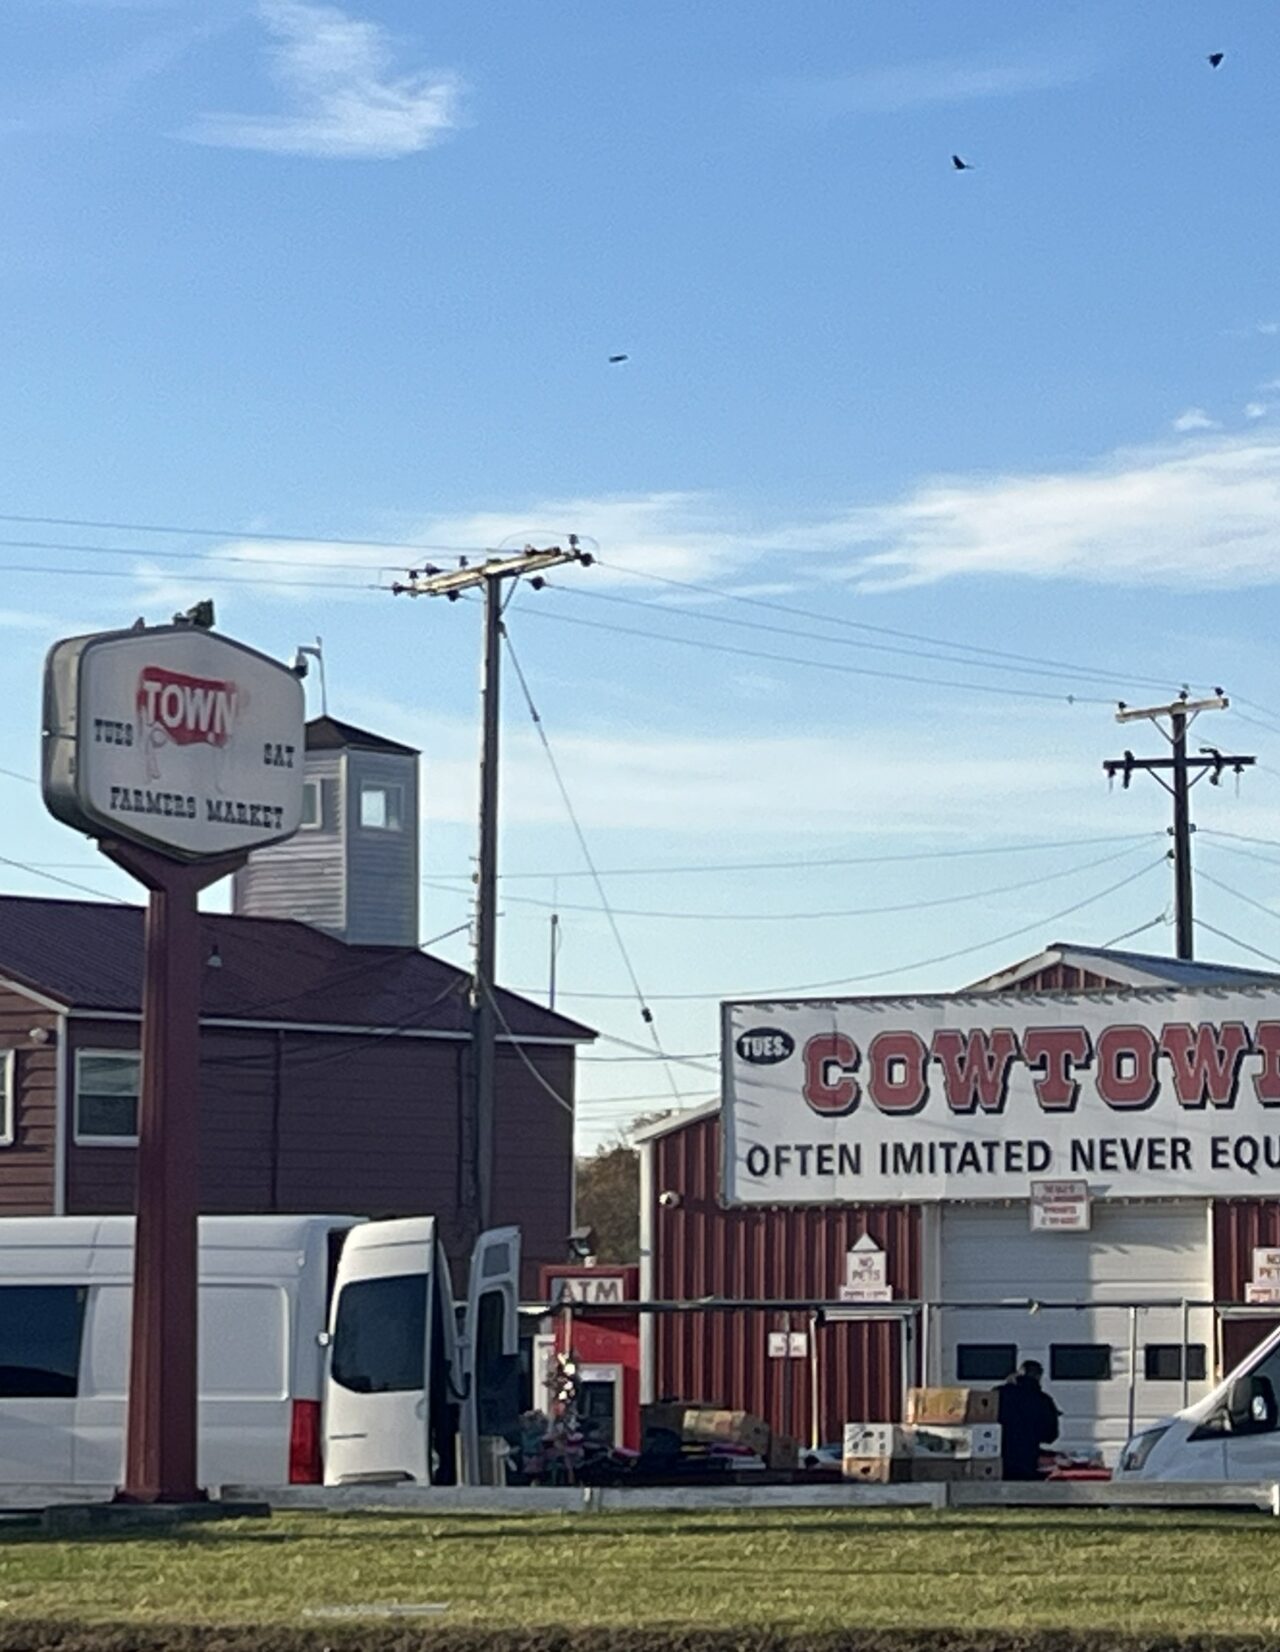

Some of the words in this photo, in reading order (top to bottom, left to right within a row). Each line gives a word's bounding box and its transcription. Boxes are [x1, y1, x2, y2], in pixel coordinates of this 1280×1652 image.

[143, 680, 237, 735] TOWN
[94, 718, 133, 746] TUES
[263, 743, 295, 769] SAT
[110, 786, 197, 818] FARMERS
[206, 798, 283, 829] MARKET
[741, 1035, 791, 1058] TUES.
[746, 1142, 861, 1177] OFTEN
[879, 1138, 1052, 1176] IMITATED
[1070, 1136, 1193, 1173] NEVER
[557, 1281, 618, 1304] ATM
